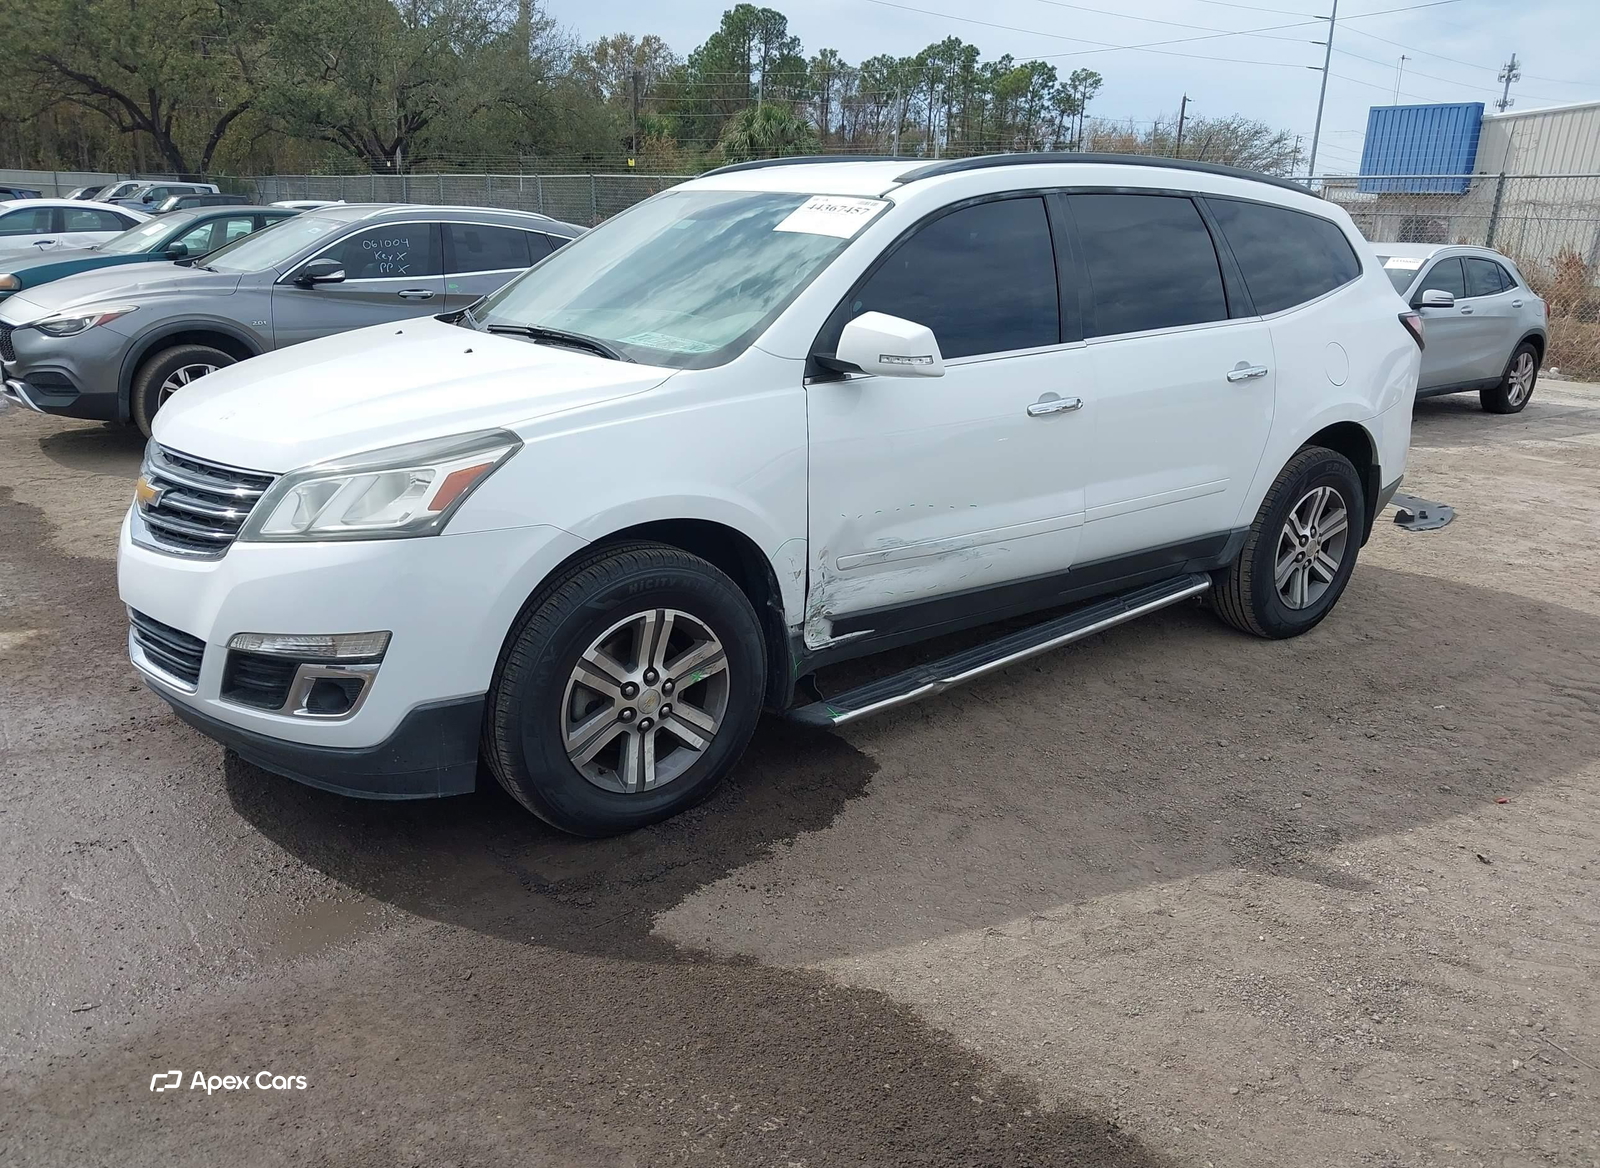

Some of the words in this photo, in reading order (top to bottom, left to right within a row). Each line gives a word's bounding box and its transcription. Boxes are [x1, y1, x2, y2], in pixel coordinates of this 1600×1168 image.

[363, 238, 410, 250] 061004
[374, 250, 394, 262] Key
[380, 262, 394, 273] PP
